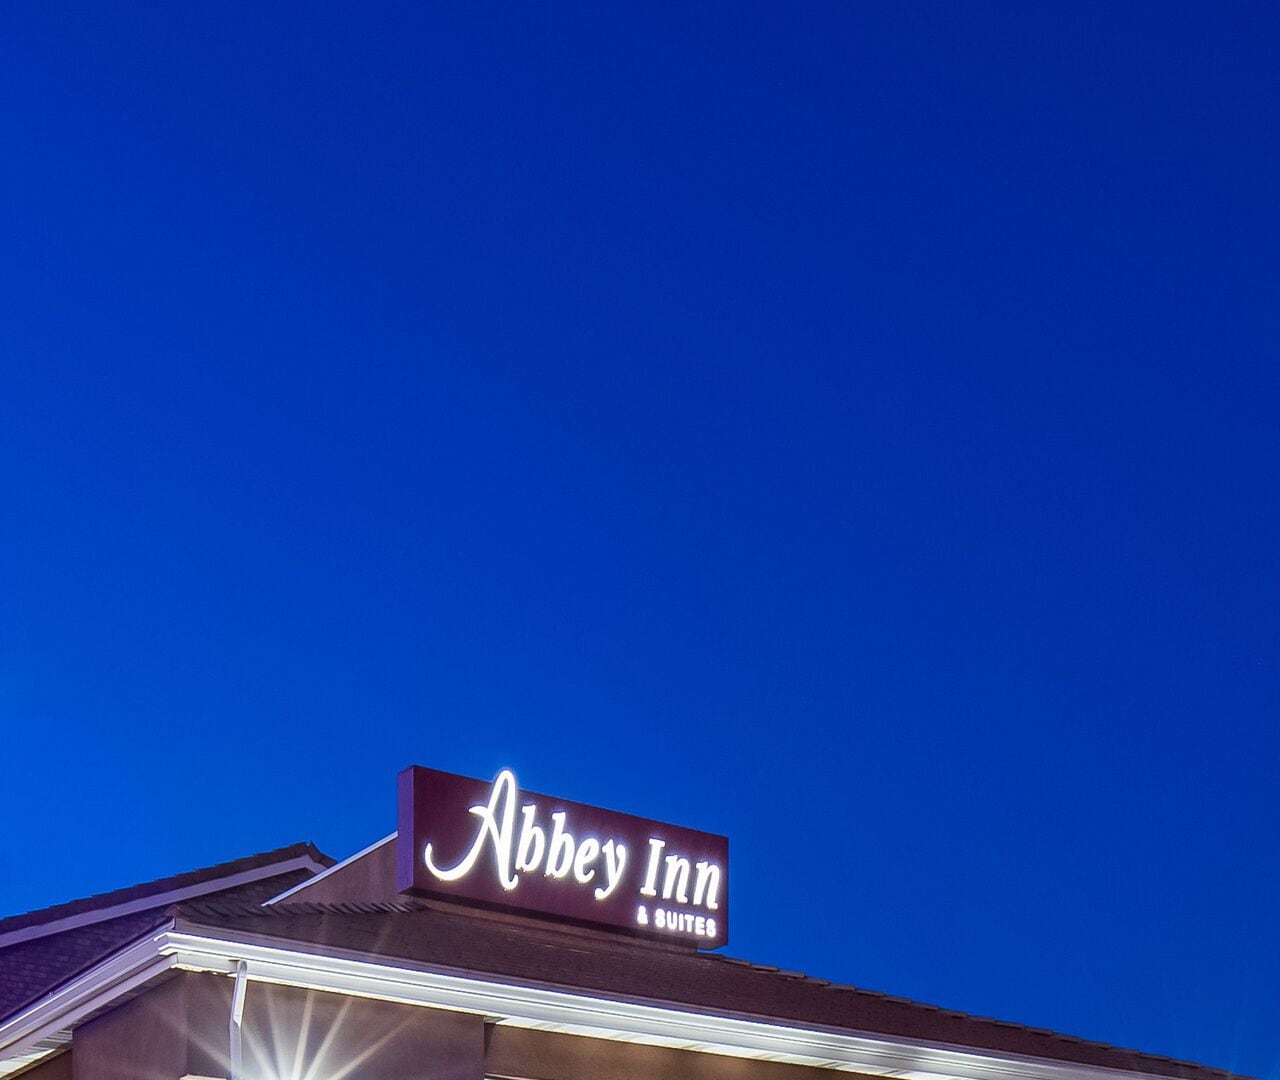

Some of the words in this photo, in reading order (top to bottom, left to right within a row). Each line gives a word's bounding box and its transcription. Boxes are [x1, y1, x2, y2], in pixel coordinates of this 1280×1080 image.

[424, 769, 628, 901] Abbey
[639, 837, 721, 910] Inn
[636, 905, 649, 925] &
[654, 907, 717, 938] SUITES
